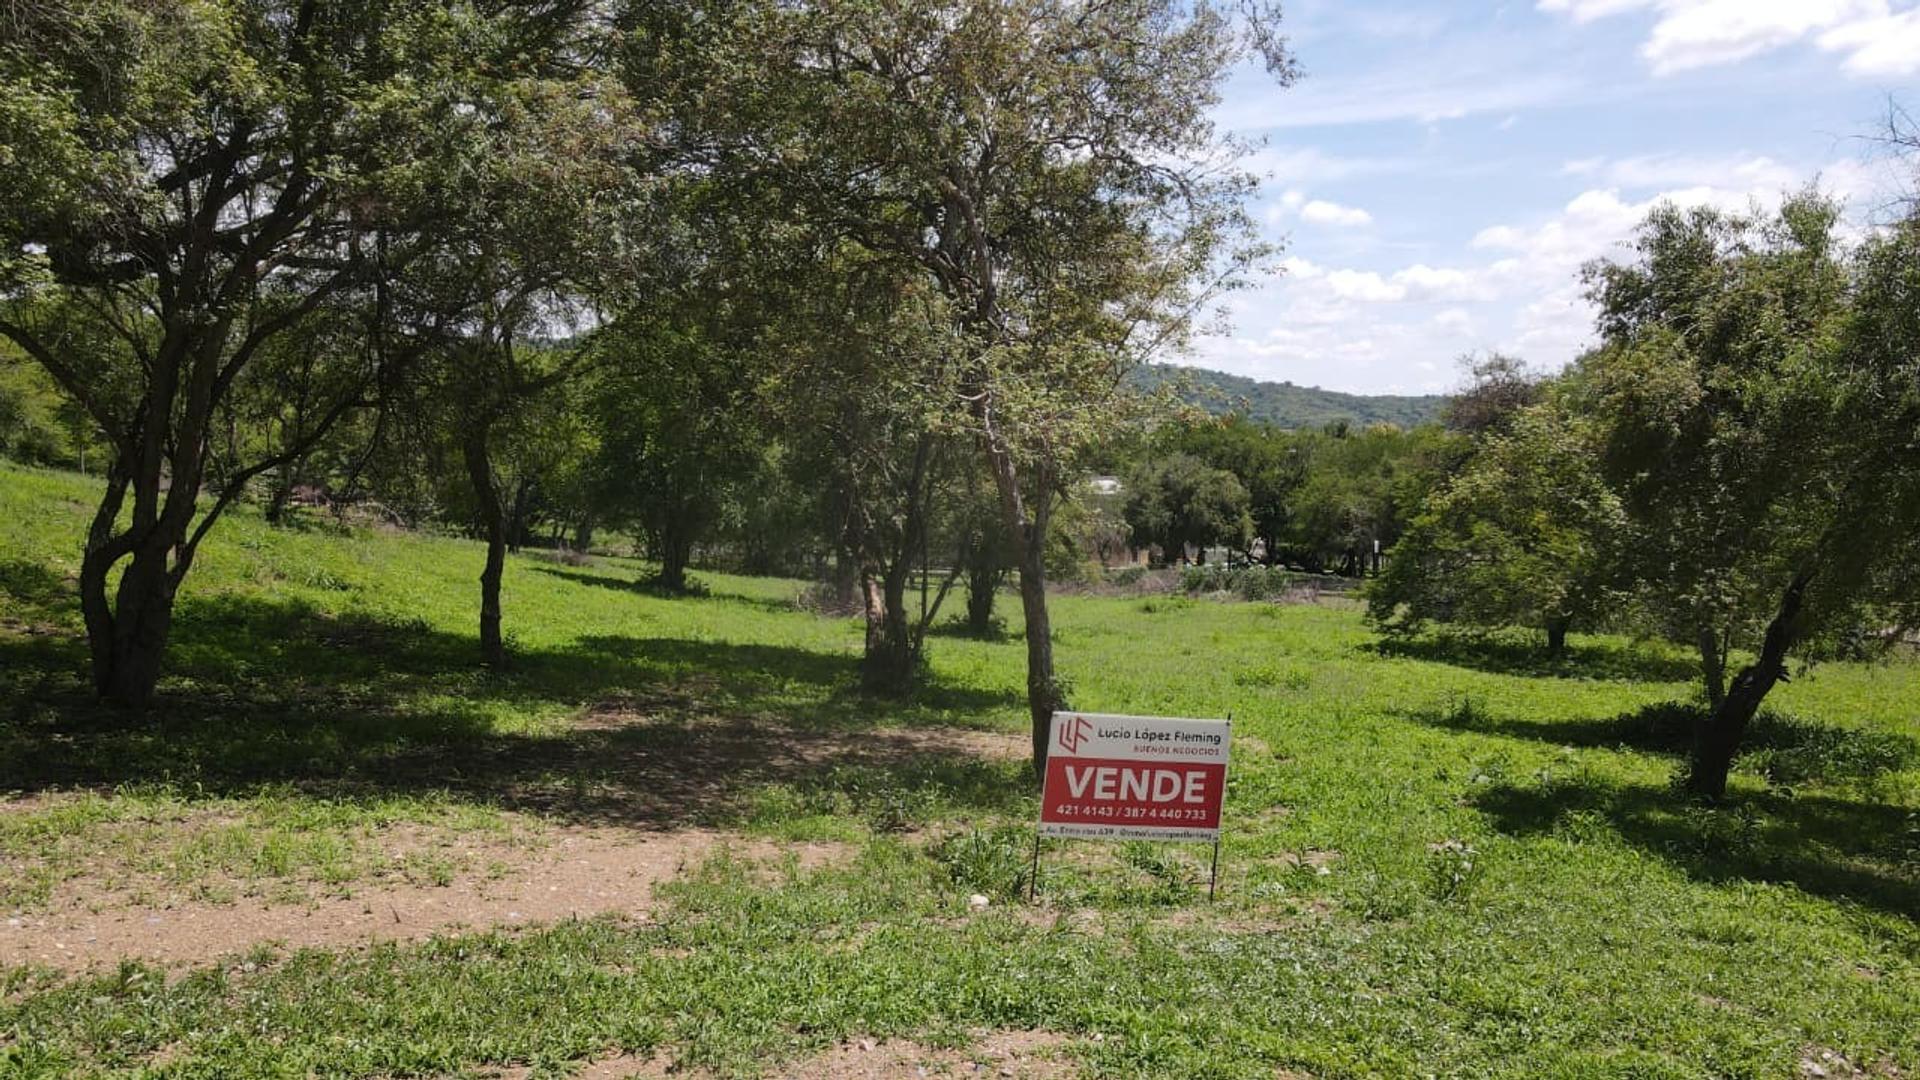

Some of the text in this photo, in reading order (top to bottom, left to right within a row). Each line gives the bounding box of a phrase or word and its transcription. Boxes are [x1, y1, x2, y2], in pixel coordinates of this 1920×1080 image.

[1098, 727, 1221, 745] Lucio López Fleming
[1133, 746, 1219, 756] BUENOS NEGOCIOS
[1065, 765, 1206, 803] VENDE
[1056, 804, 1078, 815] 421
[1083, 805, 1113, 817] 4143
[1124, 806, 1147, 818] 387
[1150, 808, 1156, 818] 4
[1160, 808, 1182, 819] 440
[1184, 809, 1206, 820] 733
